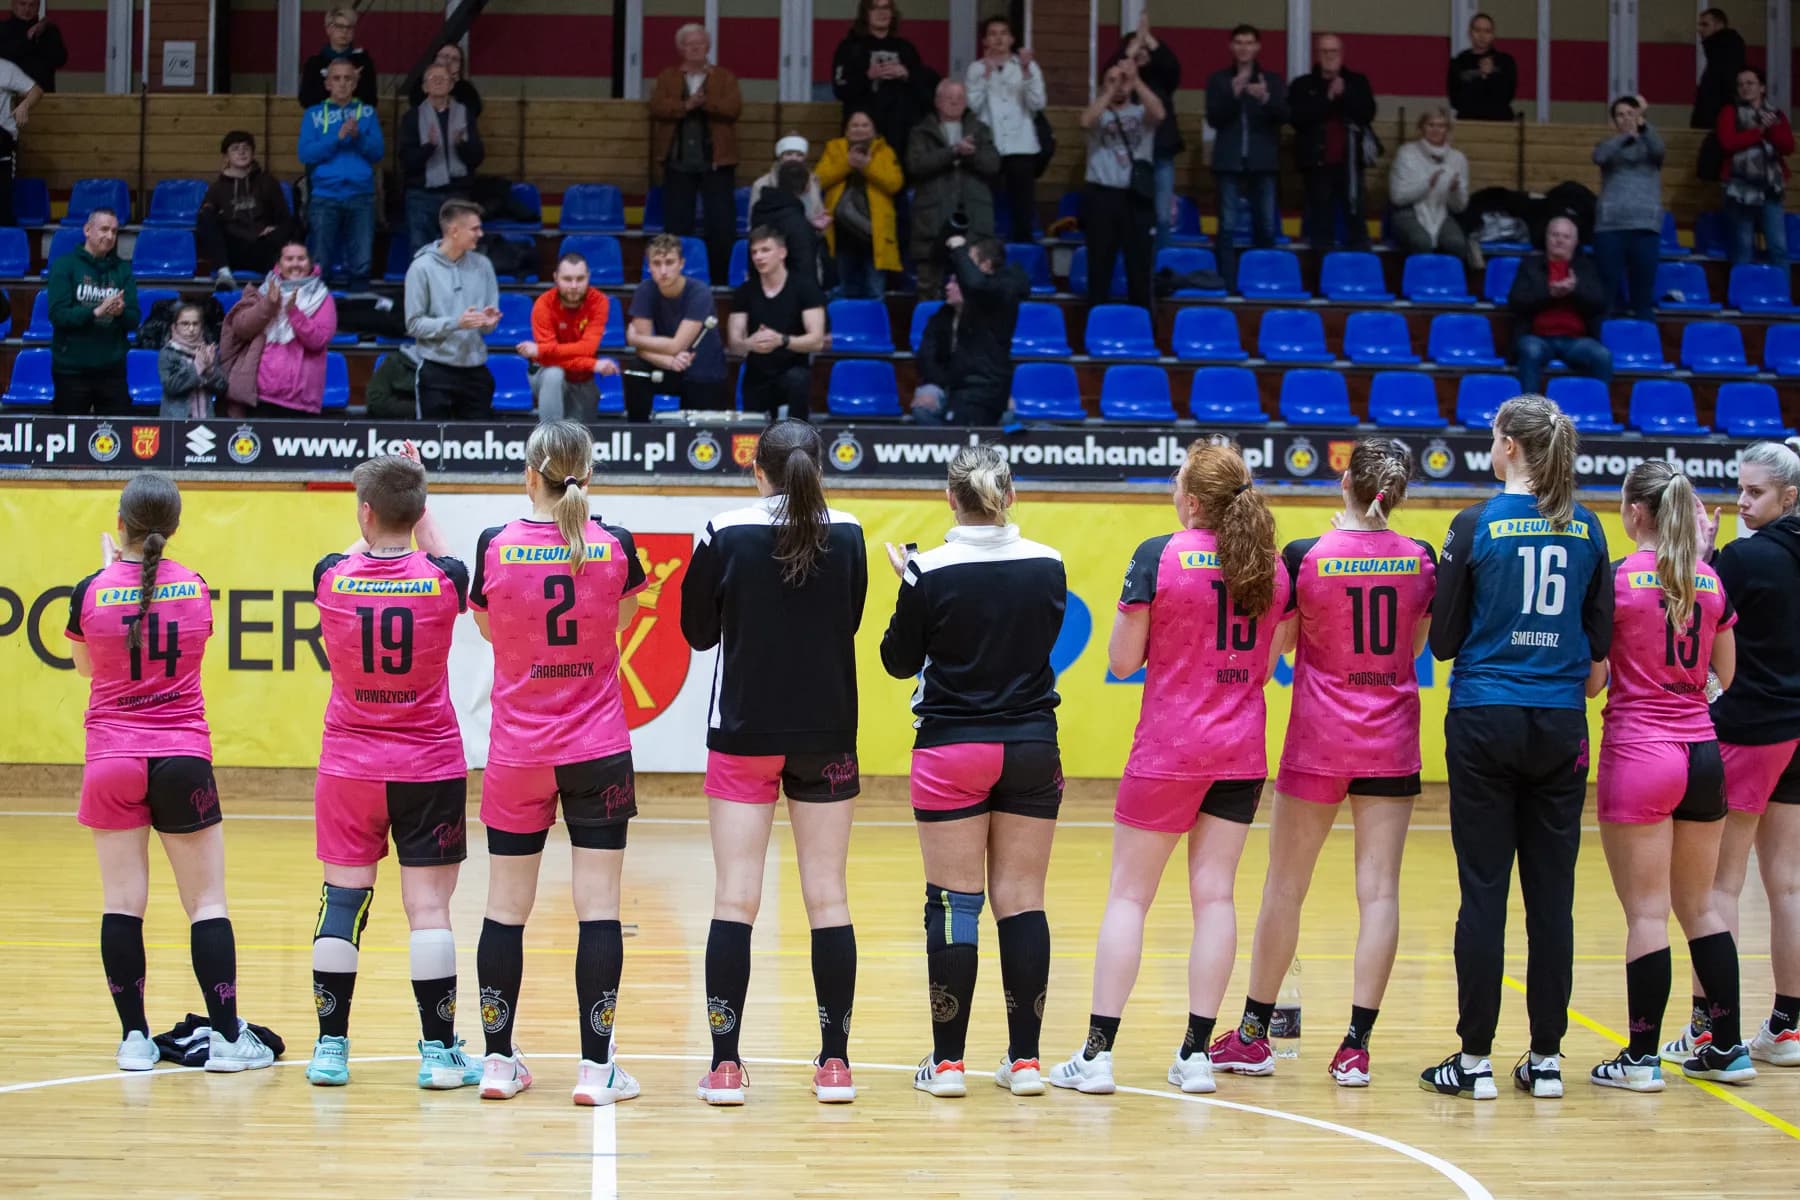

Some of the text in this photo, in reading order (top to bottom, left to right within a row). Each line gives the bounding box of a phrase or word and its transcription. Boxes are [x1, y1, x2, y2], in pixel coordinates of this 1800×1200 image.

[1516, 520, 1584, 535] LEWIAN
[1344, 559, 1416, 573] LEWIATAN
[355, 580, 433, 593] LEWIATAN
[1518, 545, 1568, 616] 16
[122, 583, 196, 602] LEIATAN
[543, 574, 578, 647] 2
[1345, 585, 1398, 656] 10
[355, 606, 414, 675] 19
[1659, 599, 1702, 669] 13
[122, 613, 182, 681] 14
[530, 662, 594, 679] GRABARCZYK
[1216, 669, 1249, 685] RZEPKA
[354, 687, 417, 704] WAWRZYCKA
